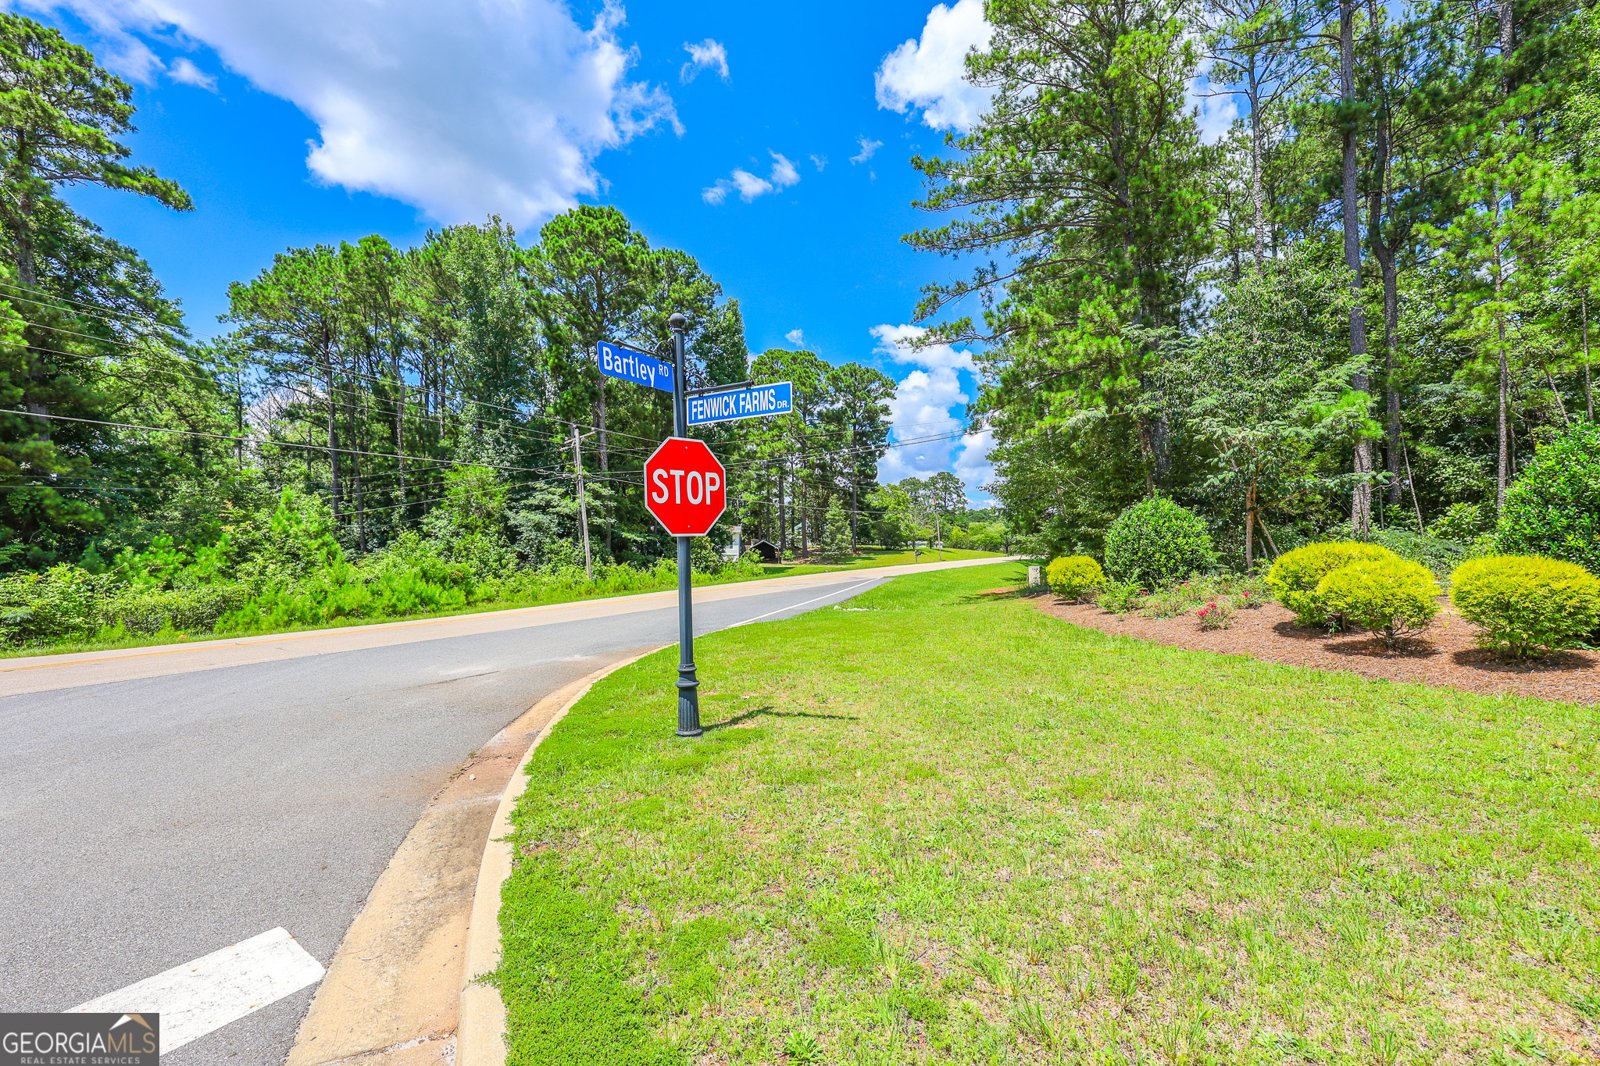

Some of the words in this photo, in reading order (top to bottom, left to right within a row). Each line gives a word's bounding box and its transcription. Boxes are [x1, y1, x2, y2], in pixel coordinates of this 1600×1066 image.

[602, 346, 656, 388] Bartley
[658, 364, 669, 377] RD
[691, 395, 737, 421] FENWICK
[739, 388, 776, 414] FARMS
[776, 400, 790, 409] DR.
[651, 468, 721, 505] STOP
